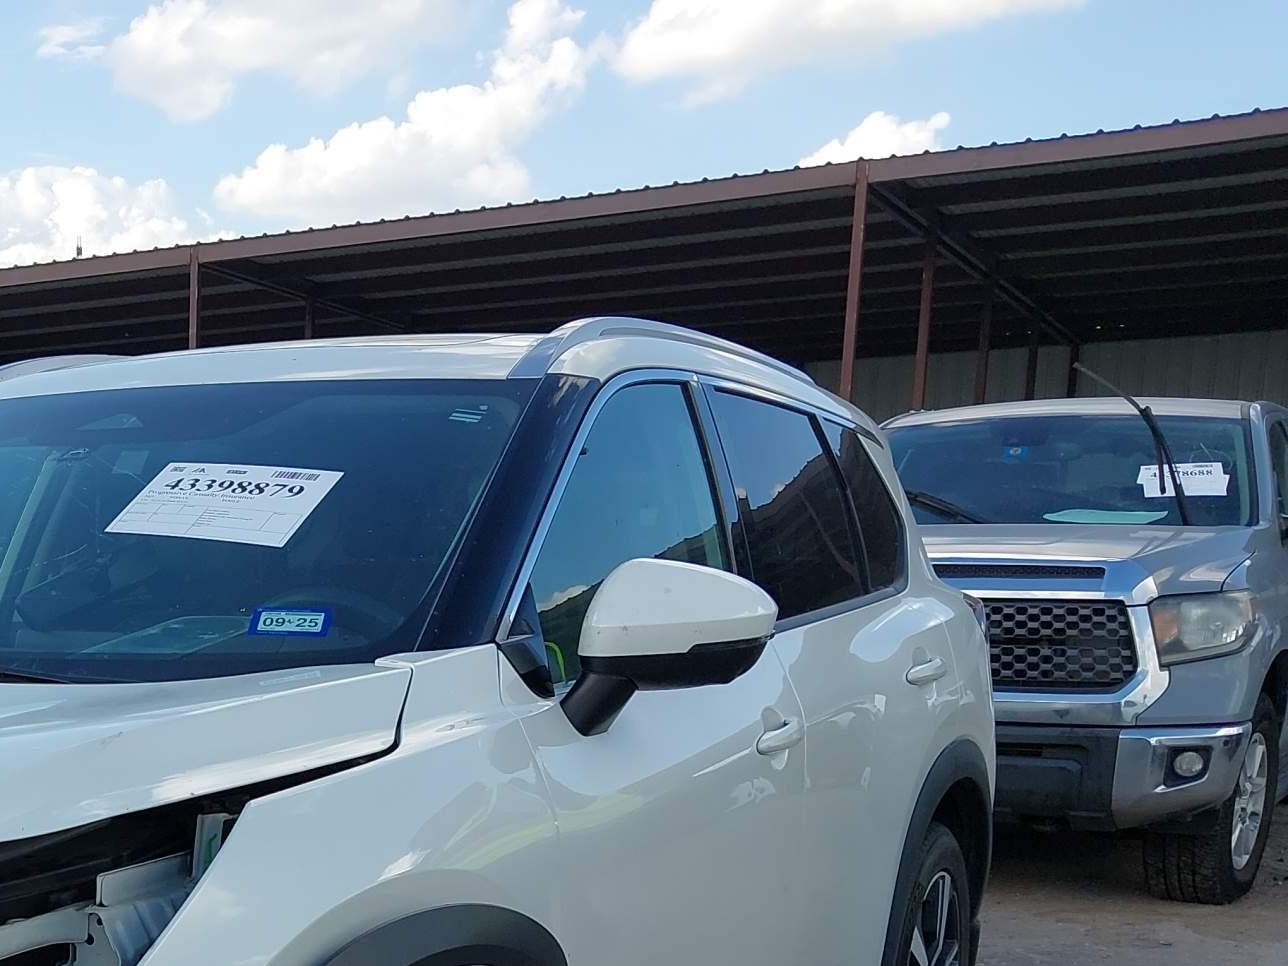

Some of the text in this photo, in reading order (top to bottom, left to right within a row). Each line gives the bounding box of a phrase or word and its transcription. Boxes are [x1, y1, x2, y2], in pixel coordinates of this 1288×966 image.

[164, 477, 305, 498] 43398879
[262, 617, 320, 628] 09 25
